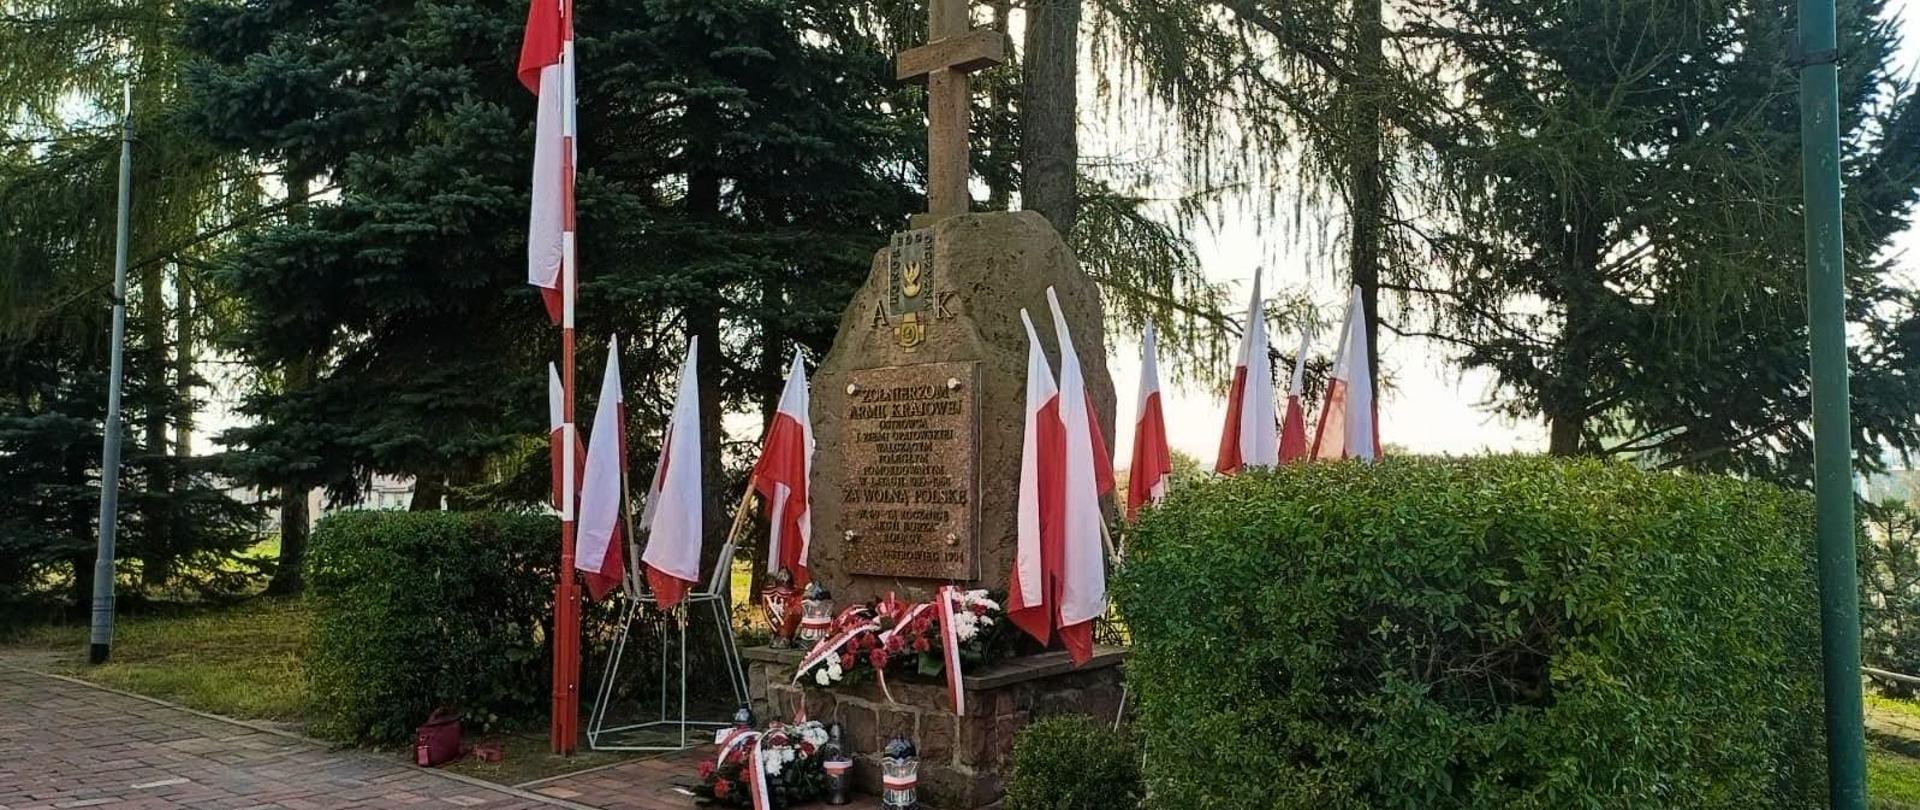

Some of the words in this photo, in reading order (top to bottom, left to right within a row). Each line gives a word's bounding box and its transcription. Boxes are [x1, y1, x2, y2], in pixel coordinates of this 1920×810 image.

[870, 300, 890, 328] A
[934, 290, 954, 319] K
[891, 399, 962, 418] KRAJOWEJ
[843, 488, 860, 503] ZA
[864, 487, 909, 506] WOLNĄ
[914, 488, 967, 508] POLSKĘ
